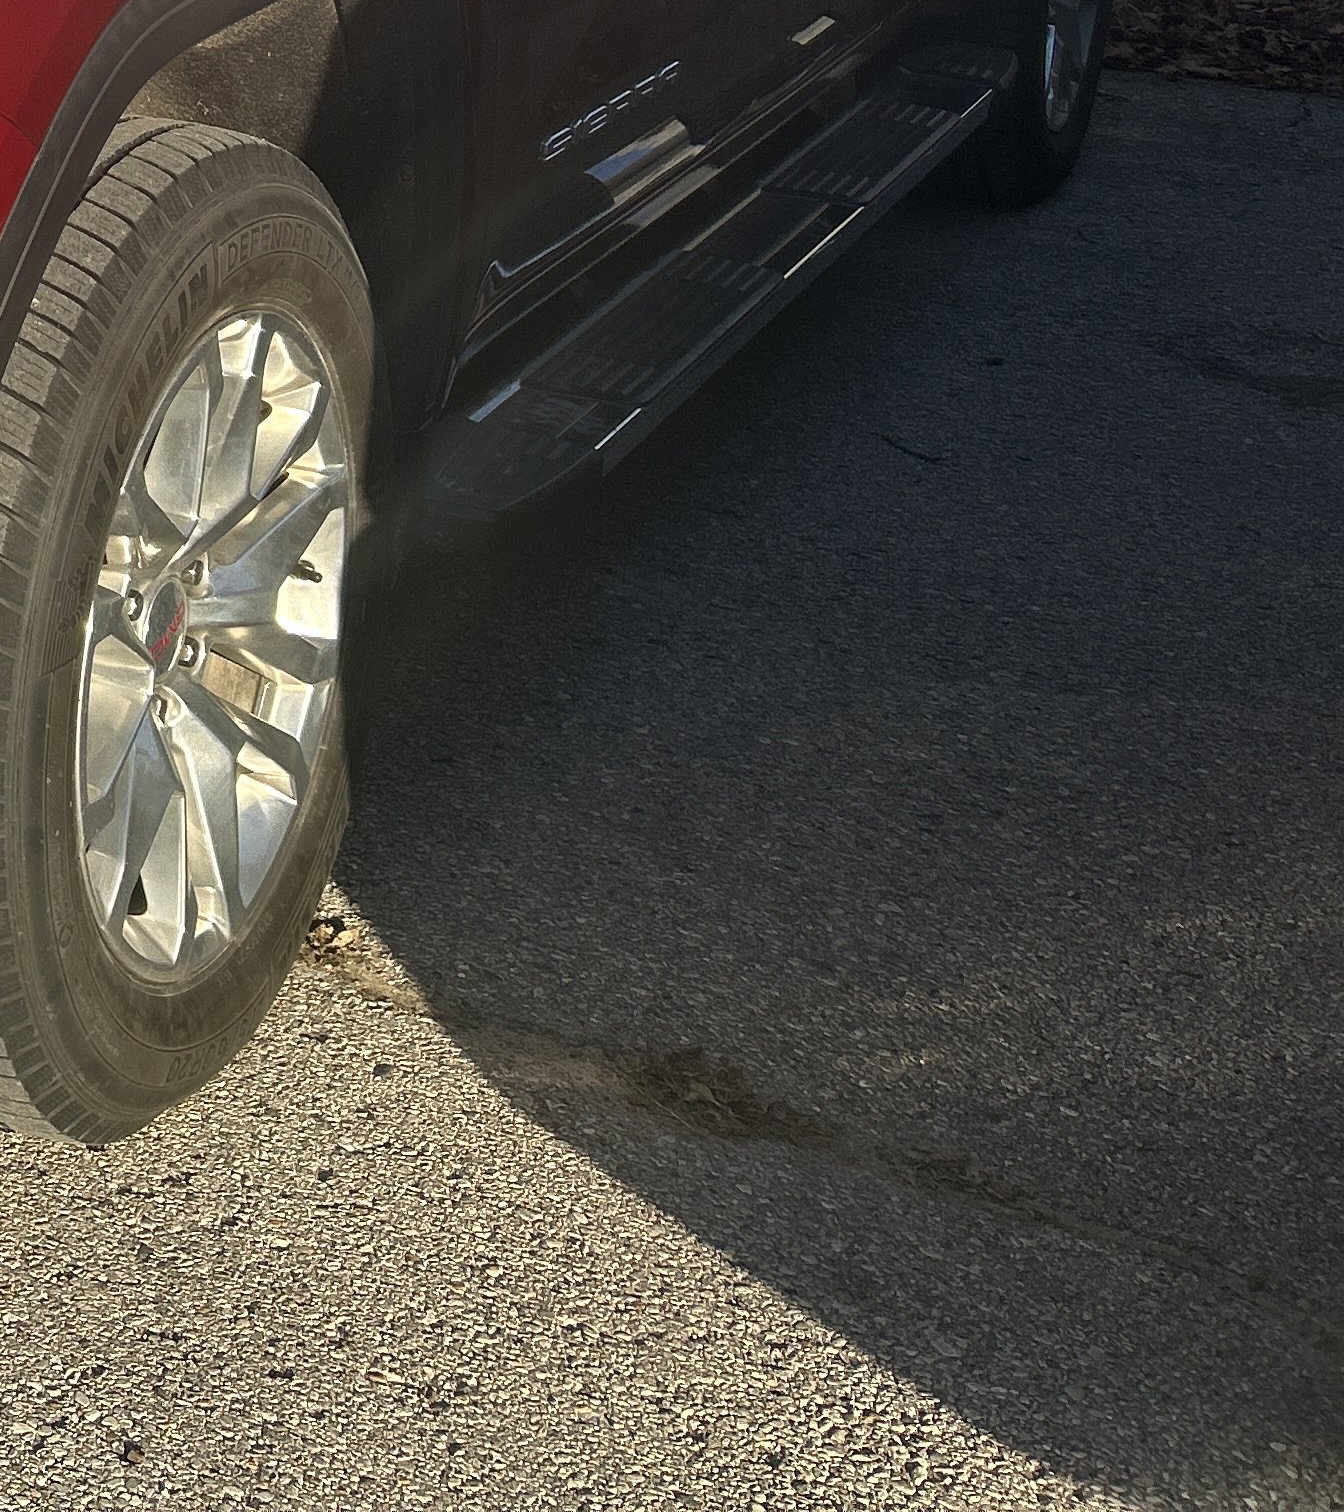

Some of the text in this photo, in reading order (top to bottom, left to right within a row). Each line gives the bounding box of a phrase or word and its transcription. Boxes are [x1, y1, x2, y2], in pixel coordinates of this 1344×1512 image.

[226, 220, 313, 273] DEFENDER
[316, 234, 344, 273] LTX
[82, 262, 210, 543] MICHELIN
